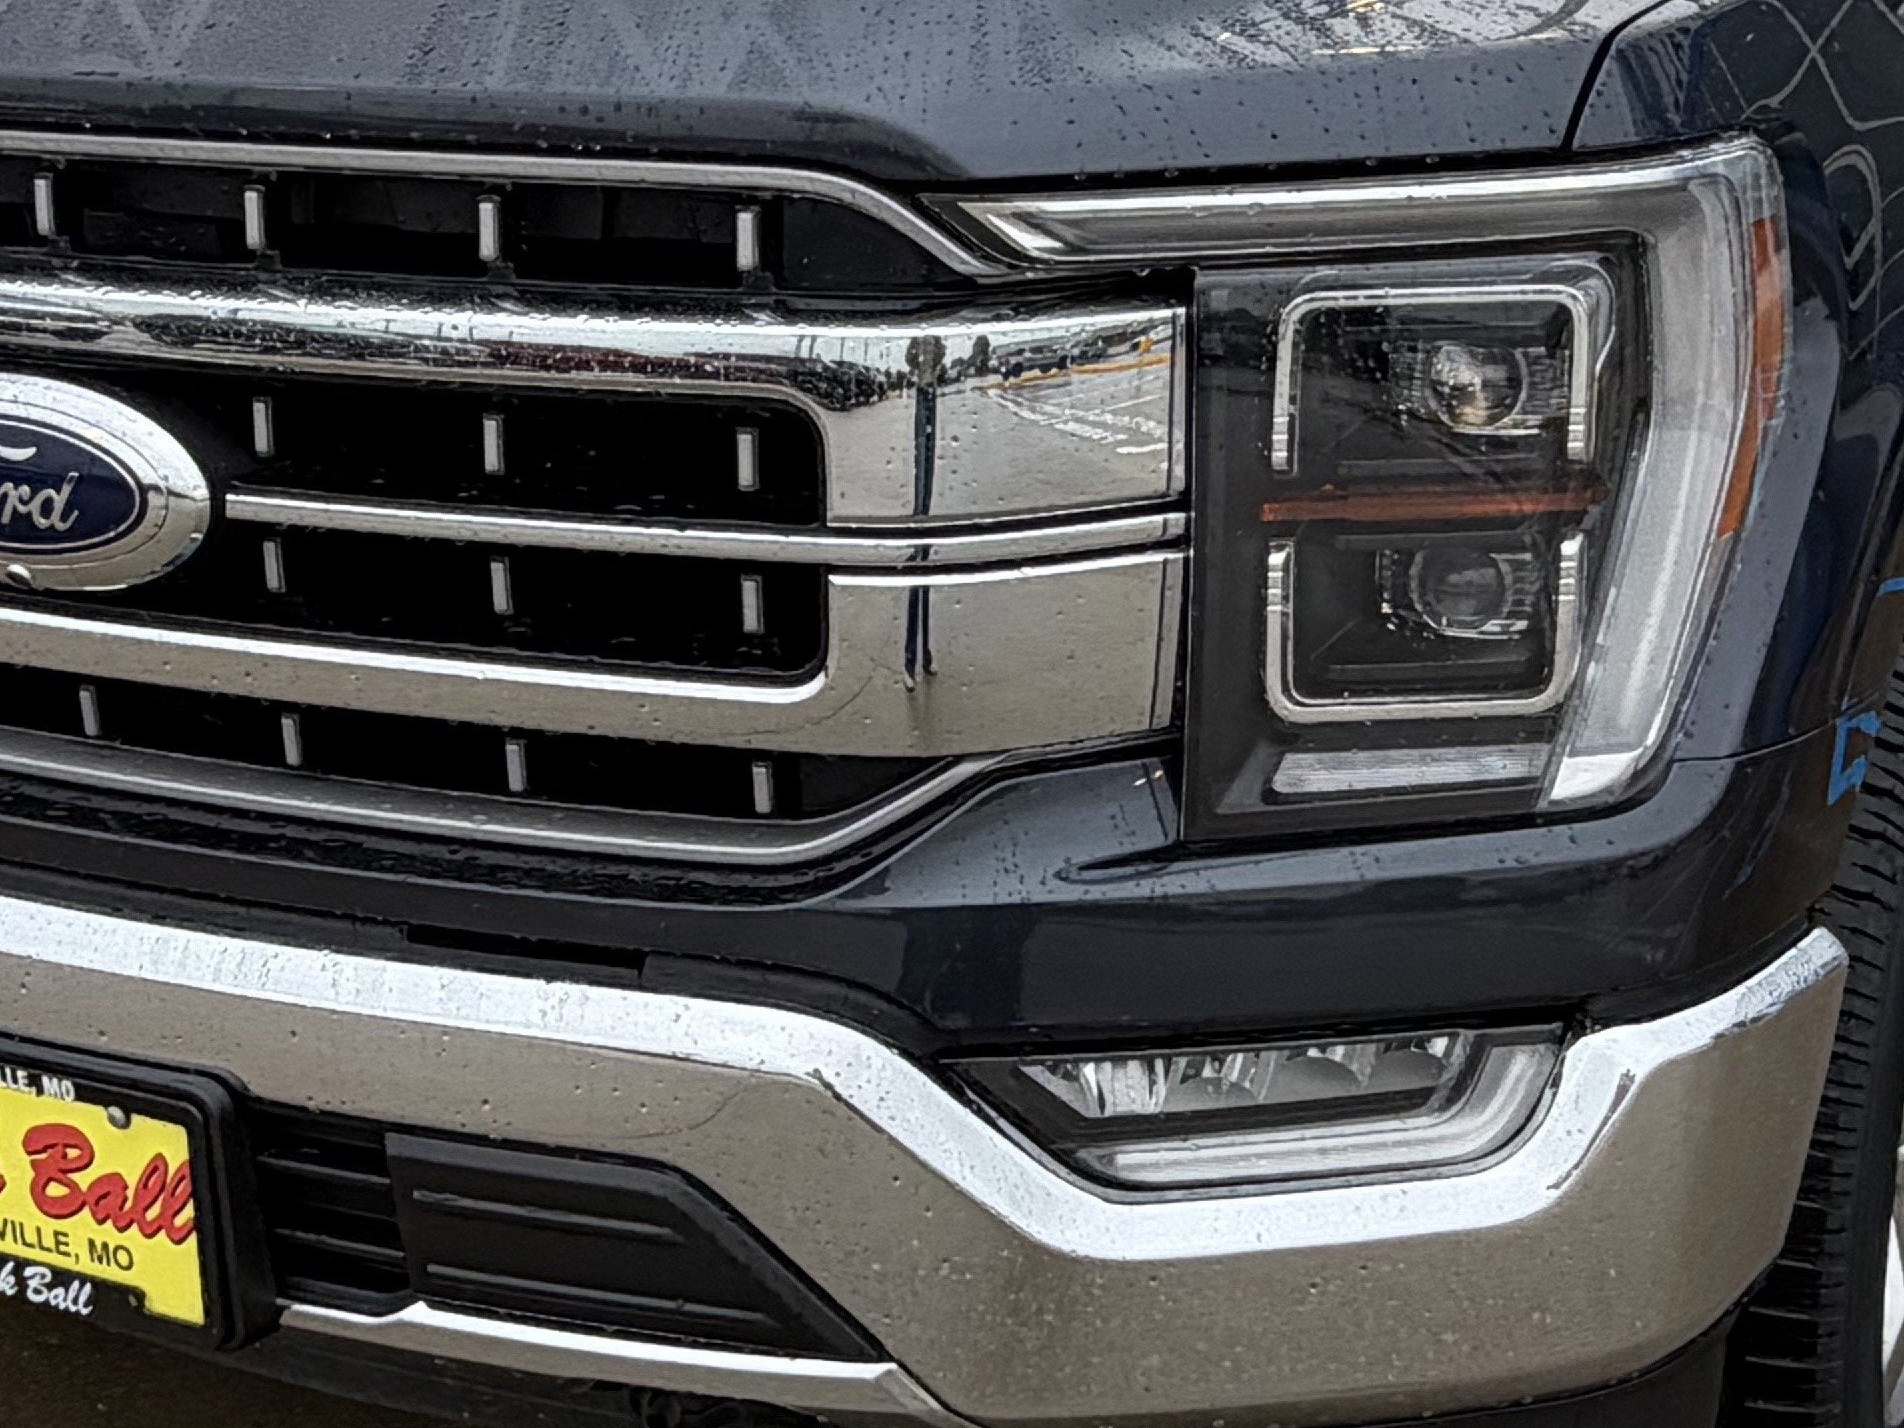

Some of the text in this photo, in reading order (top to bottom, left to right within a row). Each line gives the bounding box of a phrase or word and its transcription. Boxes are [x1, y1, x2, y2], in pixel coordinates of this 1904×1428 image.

[41, 1074, 76, 1103] MO
[23, 1123, 196, 1244] Ball
[87, 1237, 135, 1272] MO
[22, 1265, 94, 1316] Ball
